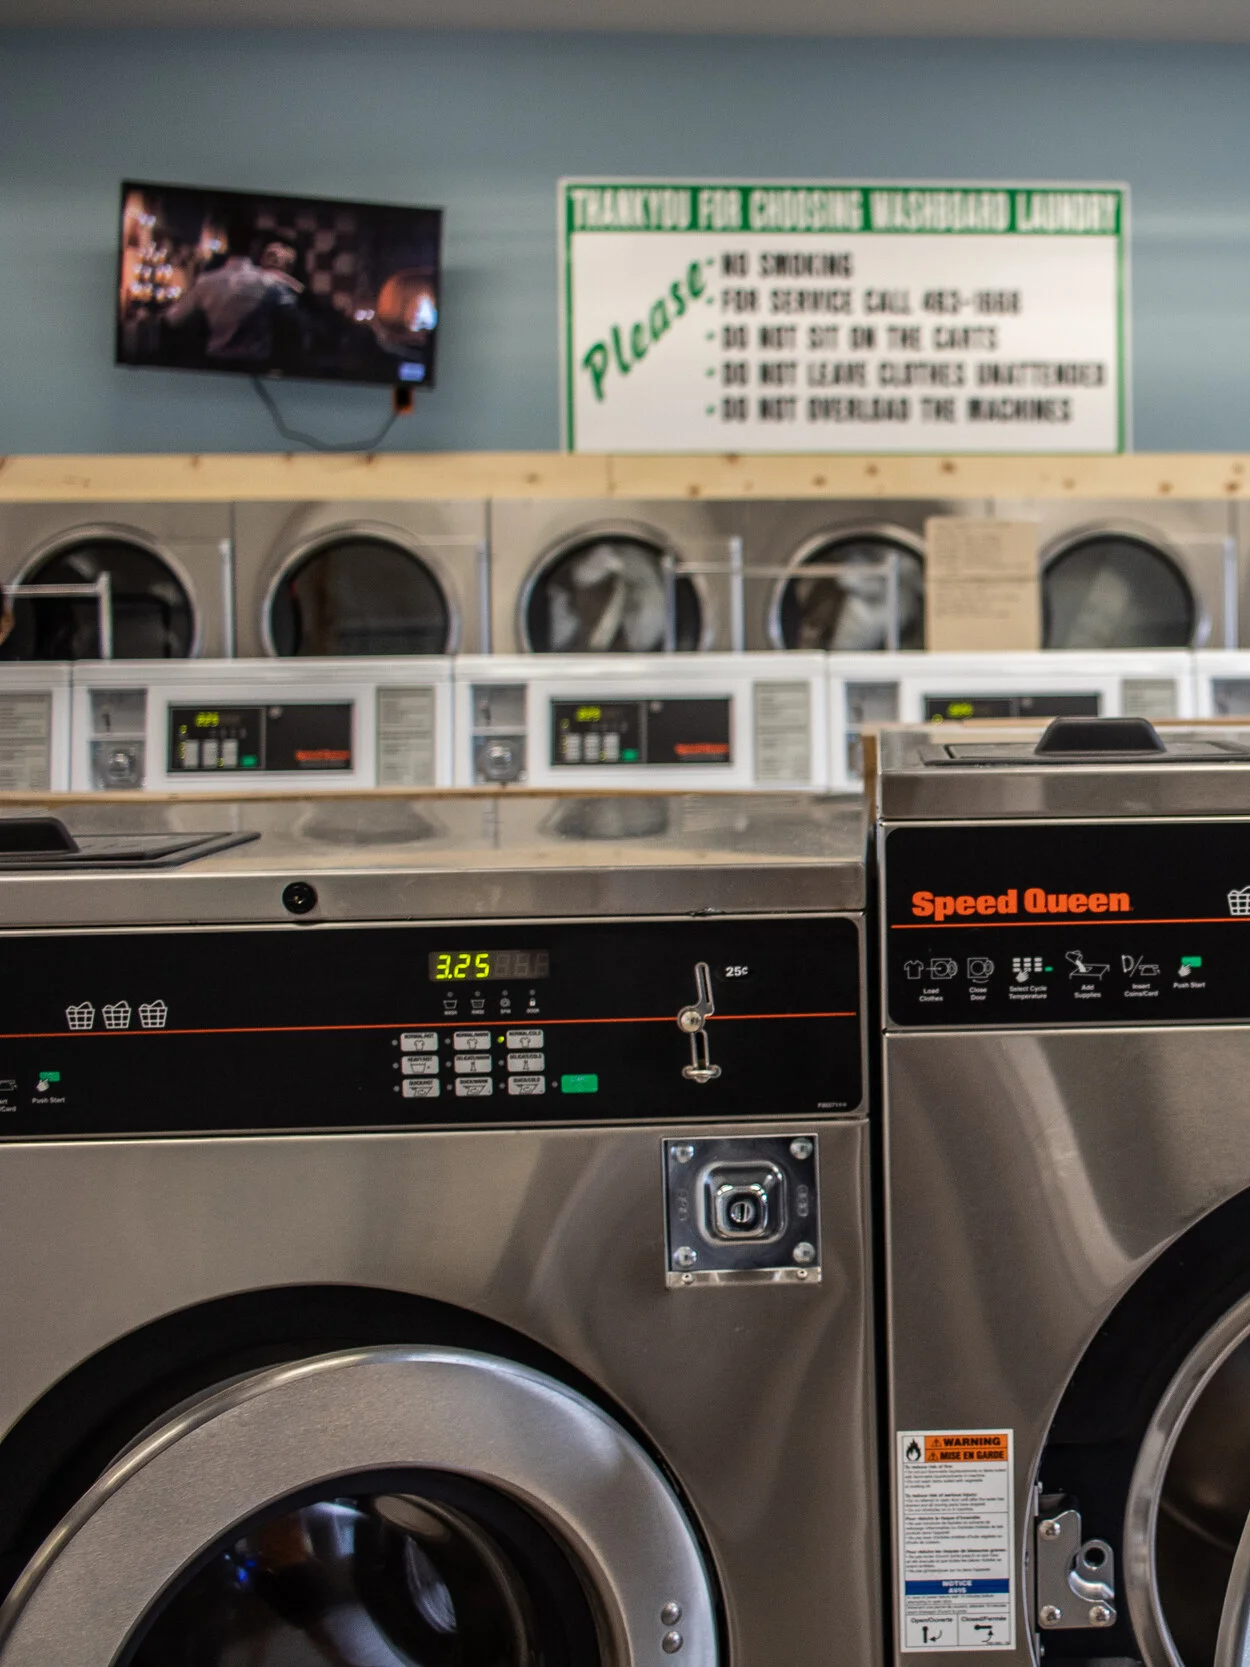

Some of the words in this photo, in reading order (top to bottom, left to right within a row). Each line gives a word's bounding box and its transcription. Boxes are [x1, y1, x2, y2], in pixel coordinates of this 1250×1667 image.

[698, 189, 742, 230] FOR
[750, 189, 862, 231] CHOOSING
[870, 190, 1010, 232] WASHBOARD
[1016, 191, 1119, 233] LAUNDRY
[722, 252, 747, 277] NO
[759, 252, 853, 278] SMOKING
[722, 288, 757, 314] FOR
[771, 288, 852, 314] SERVICE
[864, 288, 911, 315] CALL
[583, 260, 706, 401] Please
[723, 324, 748, 349] DO
[759, 324, 796, 349] NOT
[809, 324, 838, 350] SIT
[849, 324, 876, 350] ON
[887, 324, 920, 350] THE
[933, 324, 998, 351] CARTS
[723, 360, 748, 386] DO
[759, 360, 796, 386] NOT
[808, 360, 866, 387] LEAVE
[879, 360, 964, 387] CLOTHES
[975, 360, 1107, 387] UNATTENDED
[723, 396, 748, 422] DO
[759, 396, 796, 422] NOT
[808, 396, 911, 422] OVERLOAD
[920, 396, 956, 422] THE
[967, 396, 1072, 422] MACHINES
[911, 889, 1018, 921] Speed
[1024, 887, 1130, 914] Queen
[436, 953, 490, 979] 3.25
[725, 965, 748, 977] 25¢
[943, 1437, 1000, 1446] WARNING
[940, 1452, 961, 1460] MISE
[963, 1451, 974, 1459] EN
[976, 1450, 1004, 1460] GARDE
